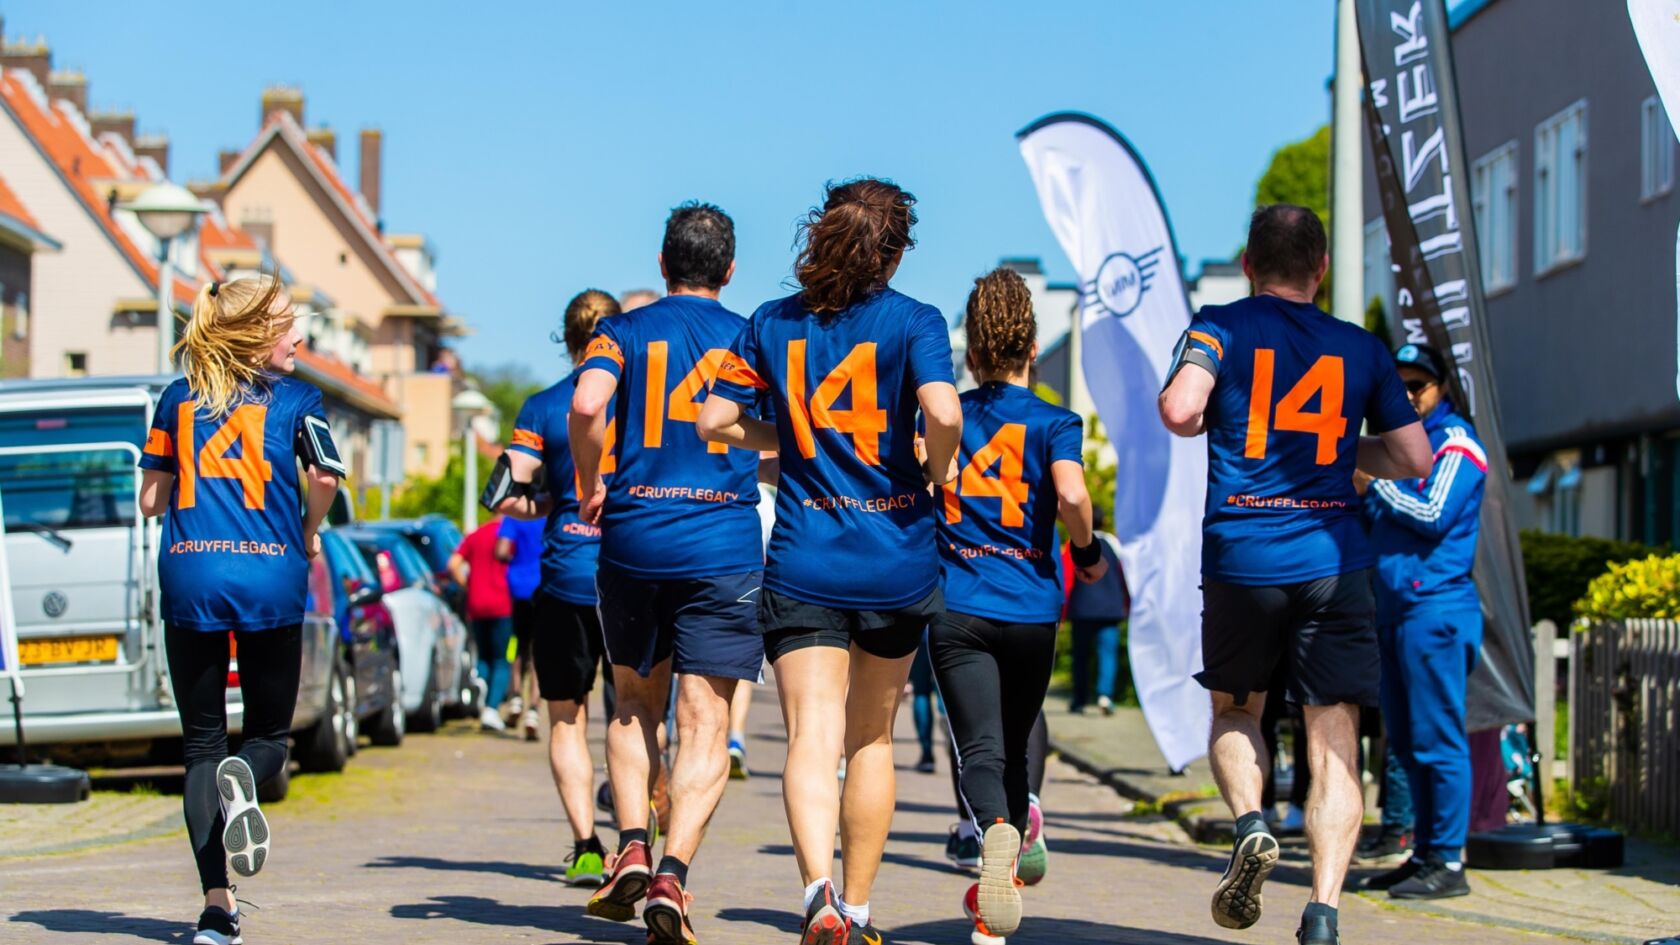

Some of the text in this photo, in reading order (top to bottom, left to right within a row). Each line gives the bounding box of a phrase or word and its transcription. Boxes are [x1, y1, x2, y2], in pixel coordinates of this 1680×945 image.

[643, 341, 733, 454] 14
[787, 338, 888, 466] 14
[1244, 348, 1347, 465] 14
[177, 400, 272, 510] 14
[627, 484, 739, 503] #CRUYFFLEGACY
[802, 493, 916, 513] #CRUYFFLEGACY
[170, 540, 287, 557] #CRUYFFLEGACY
